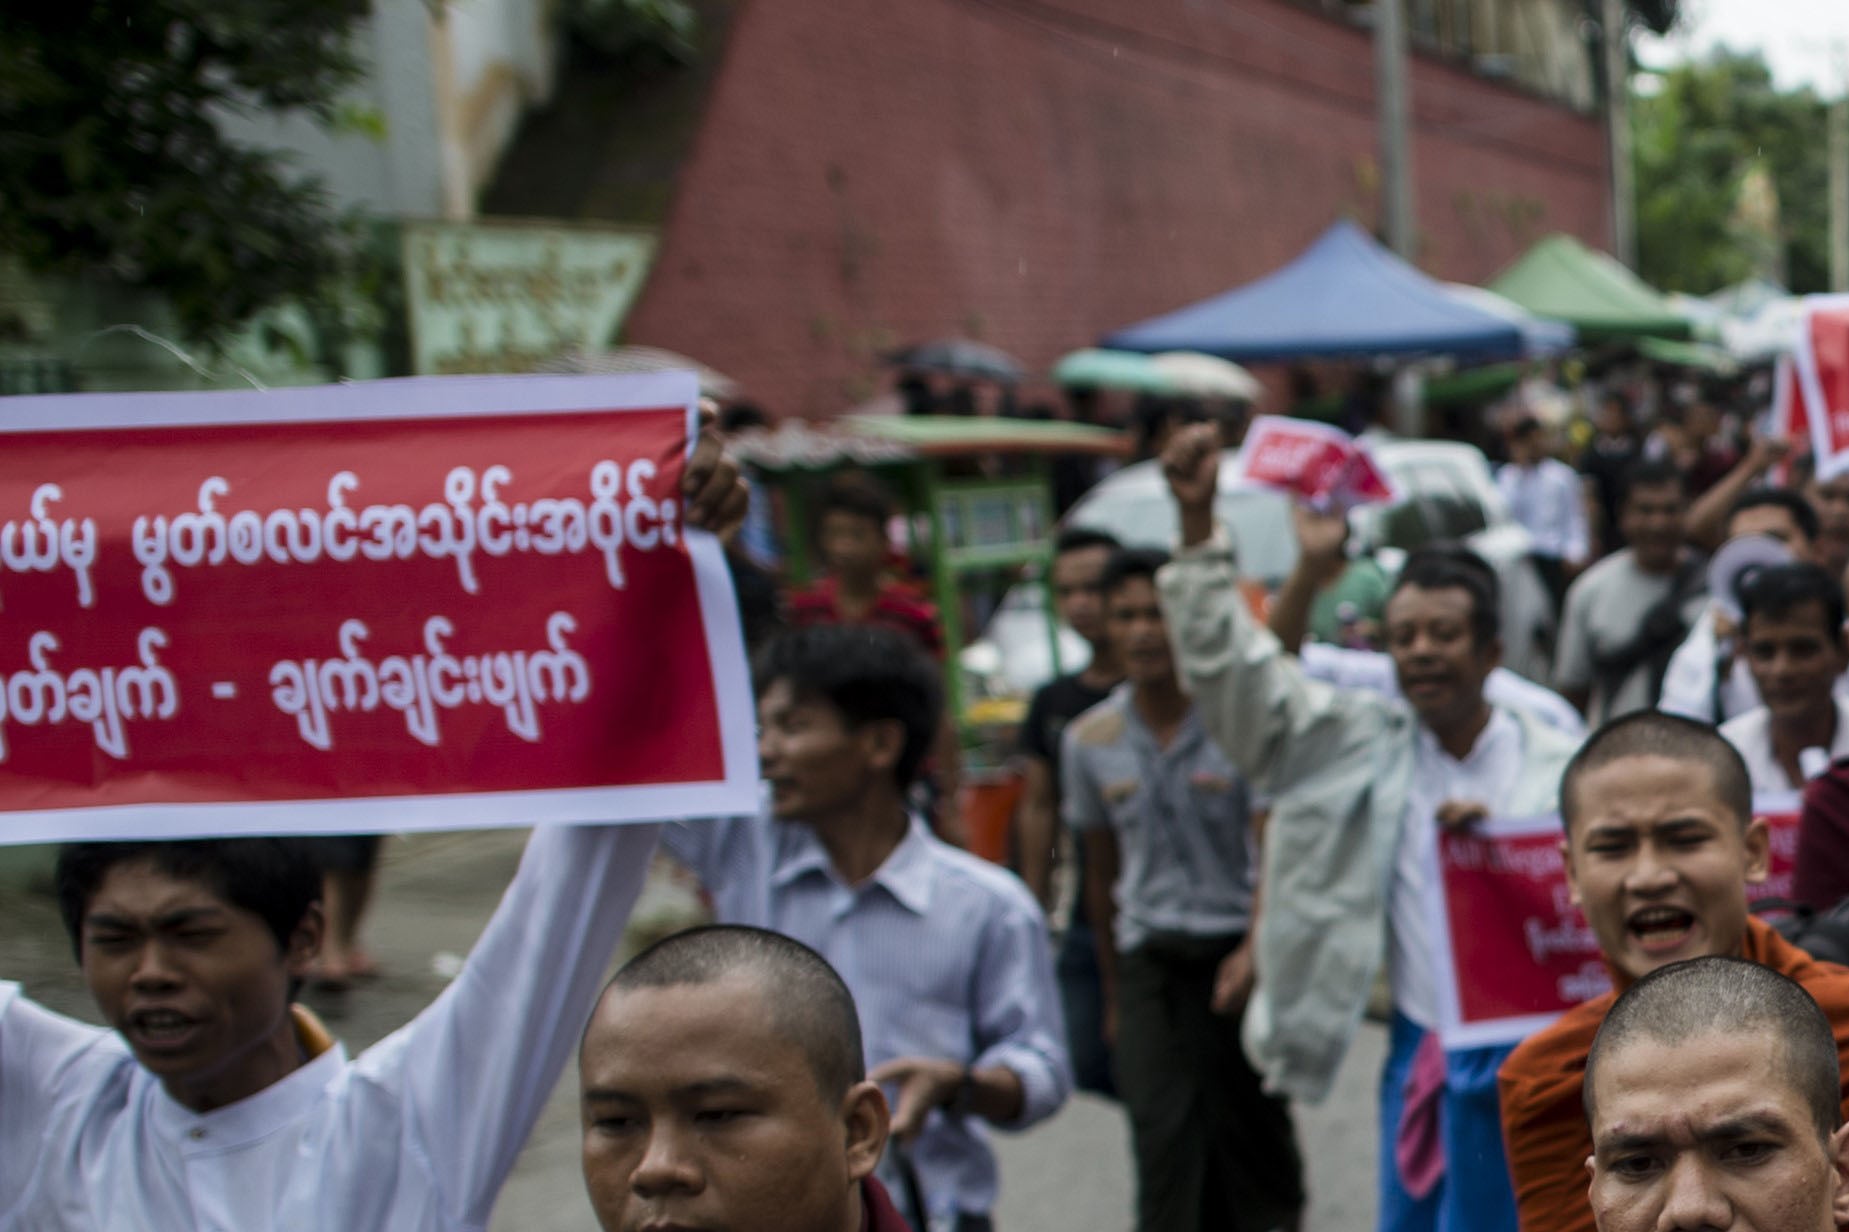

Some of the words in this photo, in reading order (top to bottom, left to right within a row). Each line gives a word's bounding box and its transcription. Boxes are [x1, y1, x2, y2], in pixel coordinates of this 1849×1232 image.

[0, 482, 98, 607] ယ်မှ
[0, 629, 178, 760] တ်ချက်
[269, 612, 590, 750] ချက်ချင်းဖျက်
